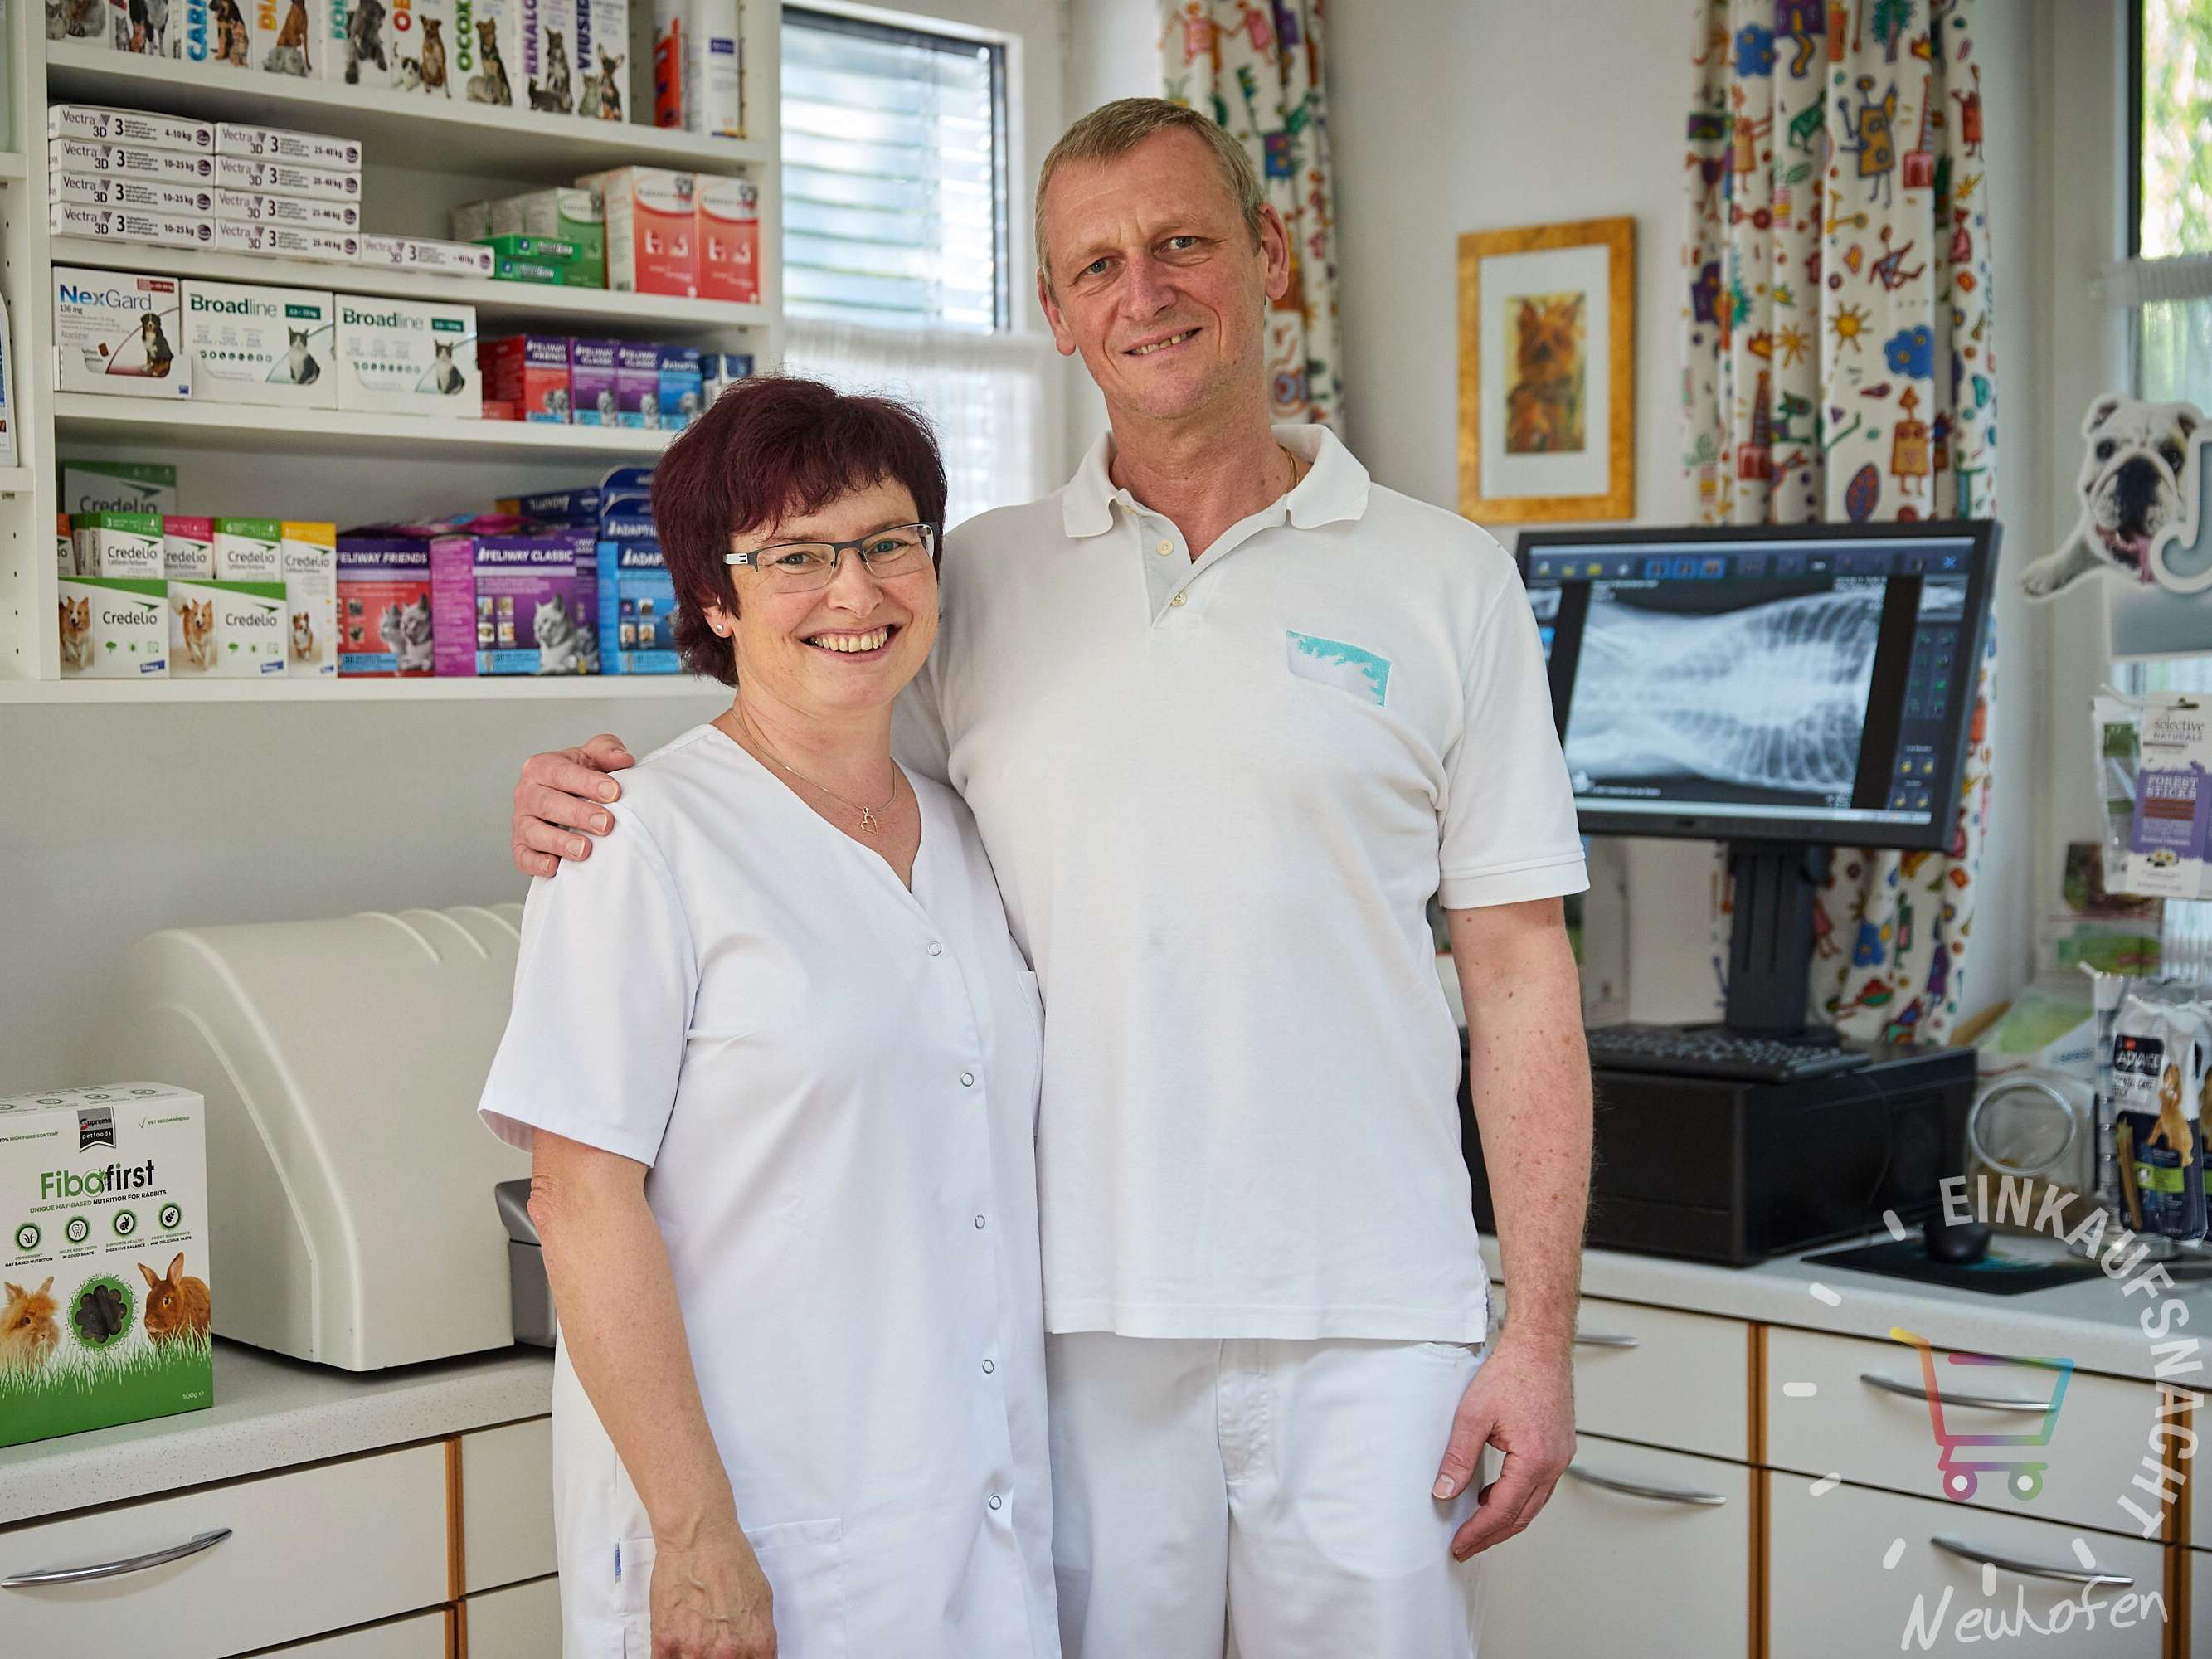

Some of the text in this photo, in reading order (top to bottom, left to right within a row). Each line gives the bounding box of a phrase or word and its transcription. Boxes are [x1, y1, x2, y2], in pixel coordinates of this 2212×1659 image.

[62, 110, 96, 125] Vectra
[114, 119, 124, 136] 3
[64, 144, 98, 158] Vectra
[270, 136, 279, 153] 3
[116, 150, 125, 167] 3
[63, 176, 96, 191] Vectra
[270, 168, 278, 184] 3
[115, 183, 124, 201] 3
[64, 208, 98, 222] Vectra
[268, 200, 276, 216] 3
[116, 215, 125, 232] 3
[268, 230, 276, 246] 3
[60, 285, 152, 310] NexGard
[190, 293, 278, 317] Broadline
[342, 307, 424, 330] Broadline
[107, 546, 158, 559] Credelio
[163, 550, 207, 563] redelio
[227, 550, 276, 564] Credelio
[382, 552, 428, 564] FRIENDS
[486, 549, 574, 562] FELIWAY CLASSIC
[284, 555, 331, 568] Credelio
[103, 611, 158, 625] Credelio
[225, 613, 278, 627] Credelio
[2154, 716, 2205, 732] selective
[2147, 774, 2199, 787] FOREST
[2146, 788, 2197, 800] STICKS
[80, 1117, 112, 1131] Supreme
[81, 1130, 112, 1141] petfoods
[30, 1204, 55, 1214] UNIQUE
[56, 1199, 92, 1210] HAY-BASED
[93, 1195, 127, 1205] NUTRITION
[141, 1190, 167, 1199] RABBITS
